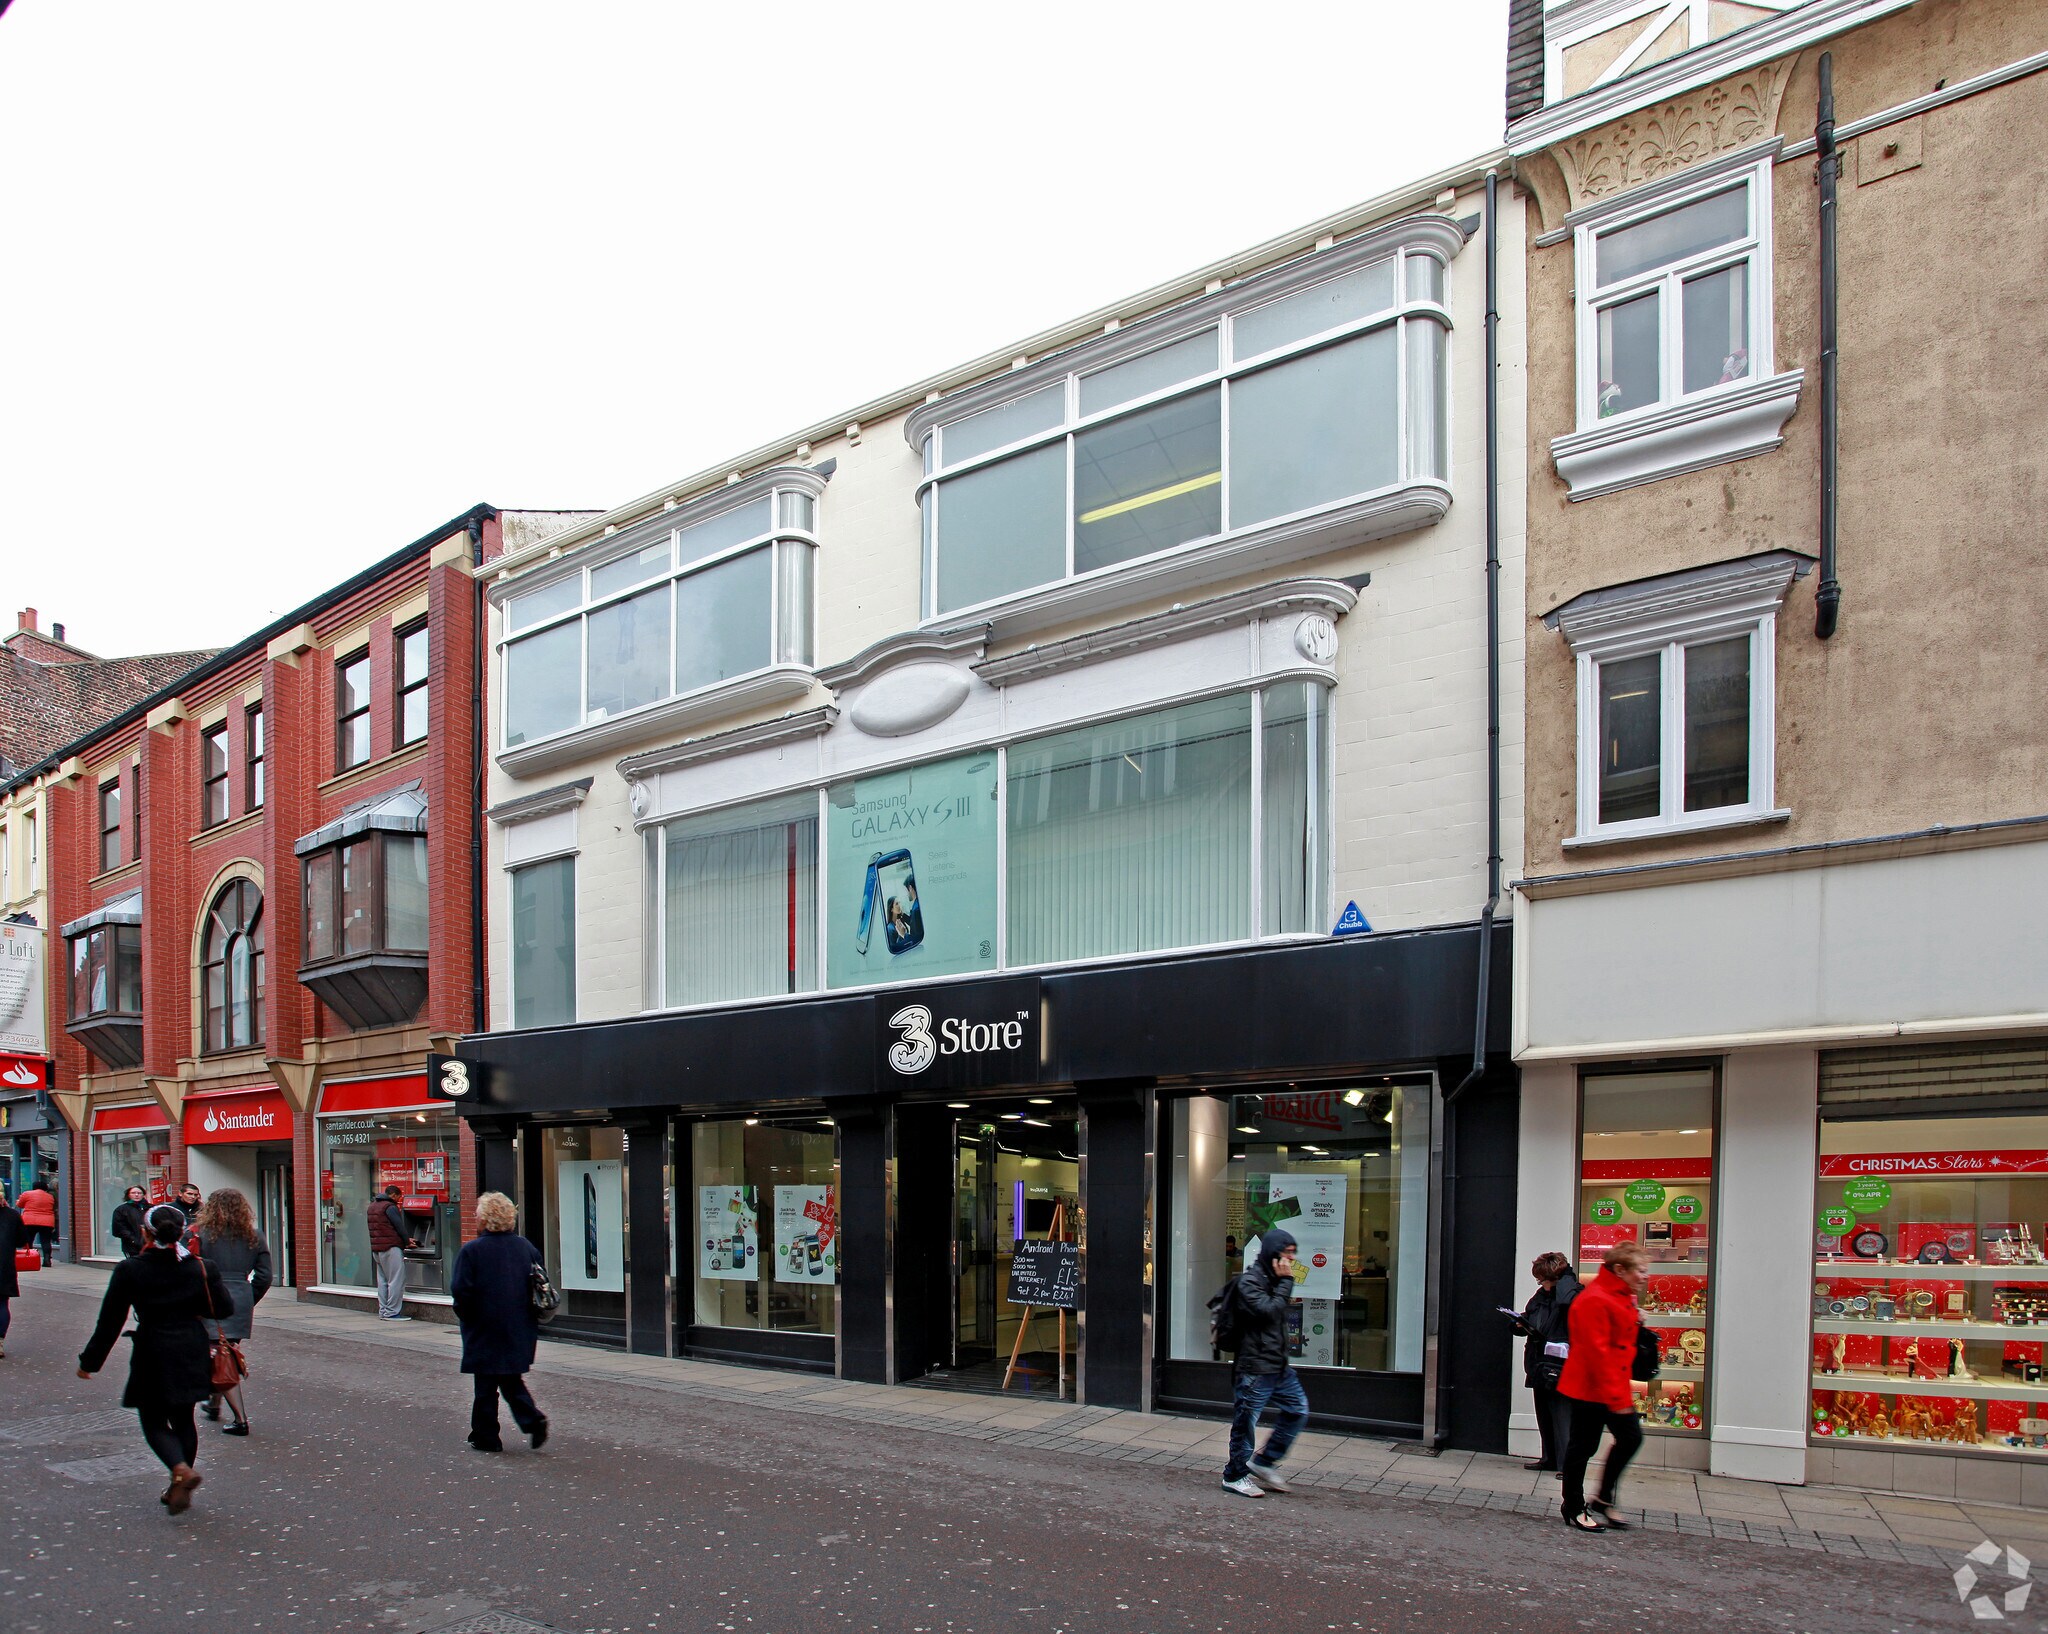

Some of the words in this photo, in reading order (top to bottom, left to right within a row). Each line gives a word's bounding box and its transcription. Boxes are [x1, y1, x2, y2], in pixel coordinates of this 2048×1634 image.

[851, 794, 907, 816] Samsung
[851, 805, 929, 838] GALAXY
[933, 796, 952, 827] S
[956, 796, 971, 818] III
[929, 850, 948, 860] Sees
[928, 861, 956, 873] Listens
[928, 871, 967, 885] Responds
[1339, 921, 1363, 929] Chubb
[9, 940, 36, 958] Loft
[980, 940, 992, 957] 3
[889, 1004, 937, 1075] 3
[940, 1018, 1023, 1055] Store
[441, 1060, 470, 1096] 3
[220, 1105, 275, 1130] Santander
[326, 1118, 375, 1131] santander.co.uk
[326, 1135, 341, 1145] 0845
[342, 1134, 354, 1144] 765
[355, 1133, 370, 1144] 4321
[1849, 1157, 1938, 1172] CHRISTMAS
[1937, 1155, 1985, 1170] Stars
[1021, 1240, 1055, 1253] Android
[1060, 1242, 1078, 1253] Phon
[1018, 1276, 1046, 1285] INTERNET!
[1033, 1286, 1040, 1297] 2
[1040, 1290, 1051, 1298] for
